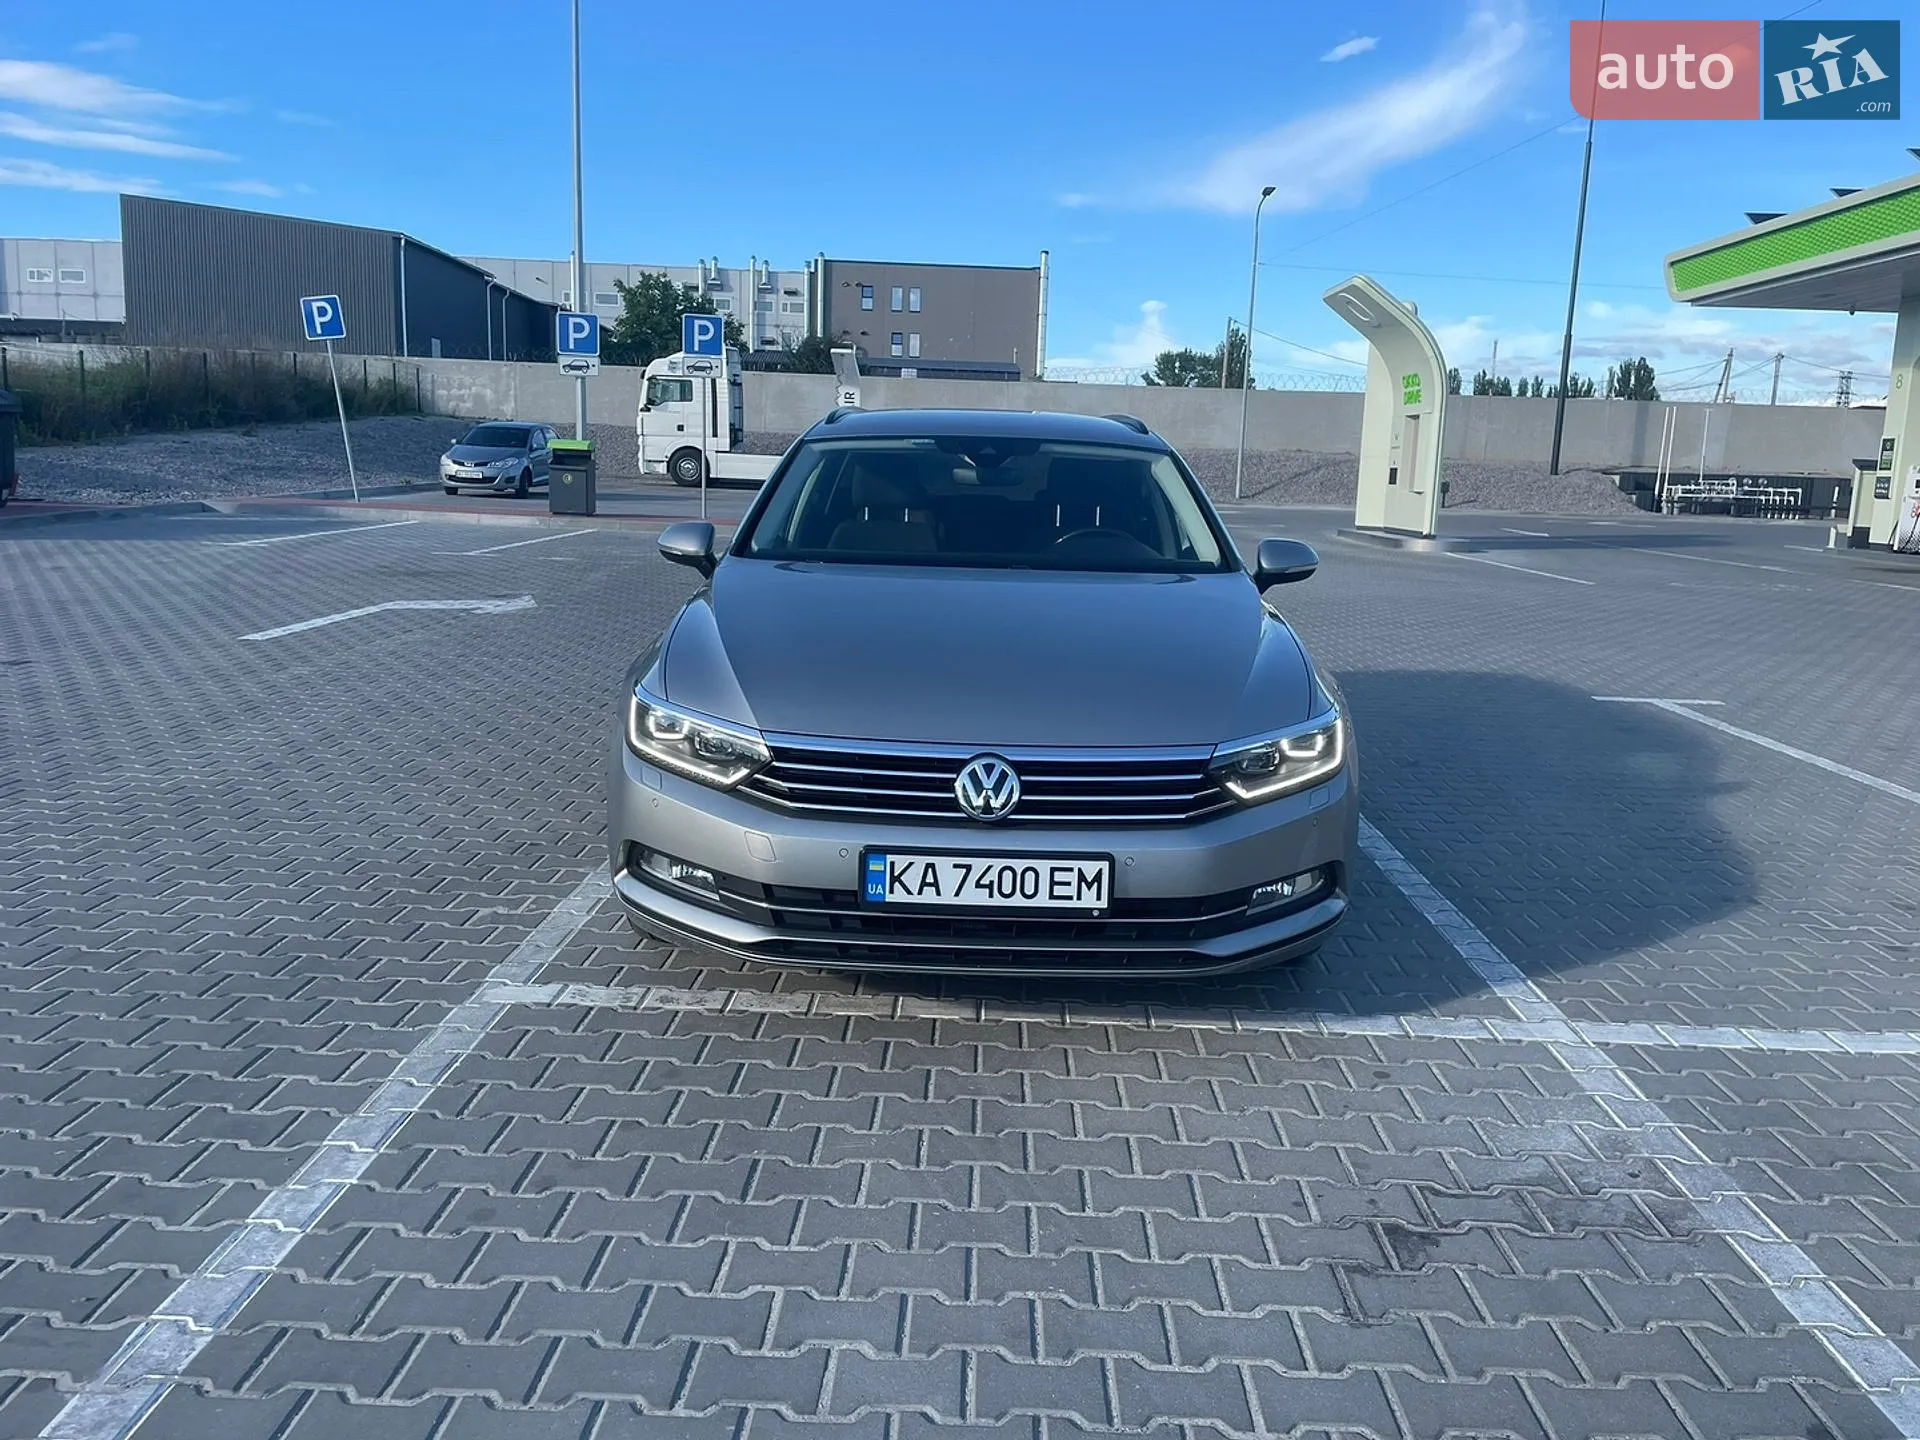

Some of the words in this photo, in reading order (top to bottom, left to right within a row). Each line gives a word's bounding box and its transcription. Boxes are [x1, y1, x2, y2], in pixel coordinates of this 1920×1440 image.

[312, 301, 333, 334] P
[568, 317, 591, 350] P
[694, 319, 715, 352] P
[843, 391, 855, 405] IR
[868, 883, 884, 896] UA
[889, 860, 942, 897] KA
[952, 863, 1040, 900] 7400
[1048, 866, 1103, 902] EM
